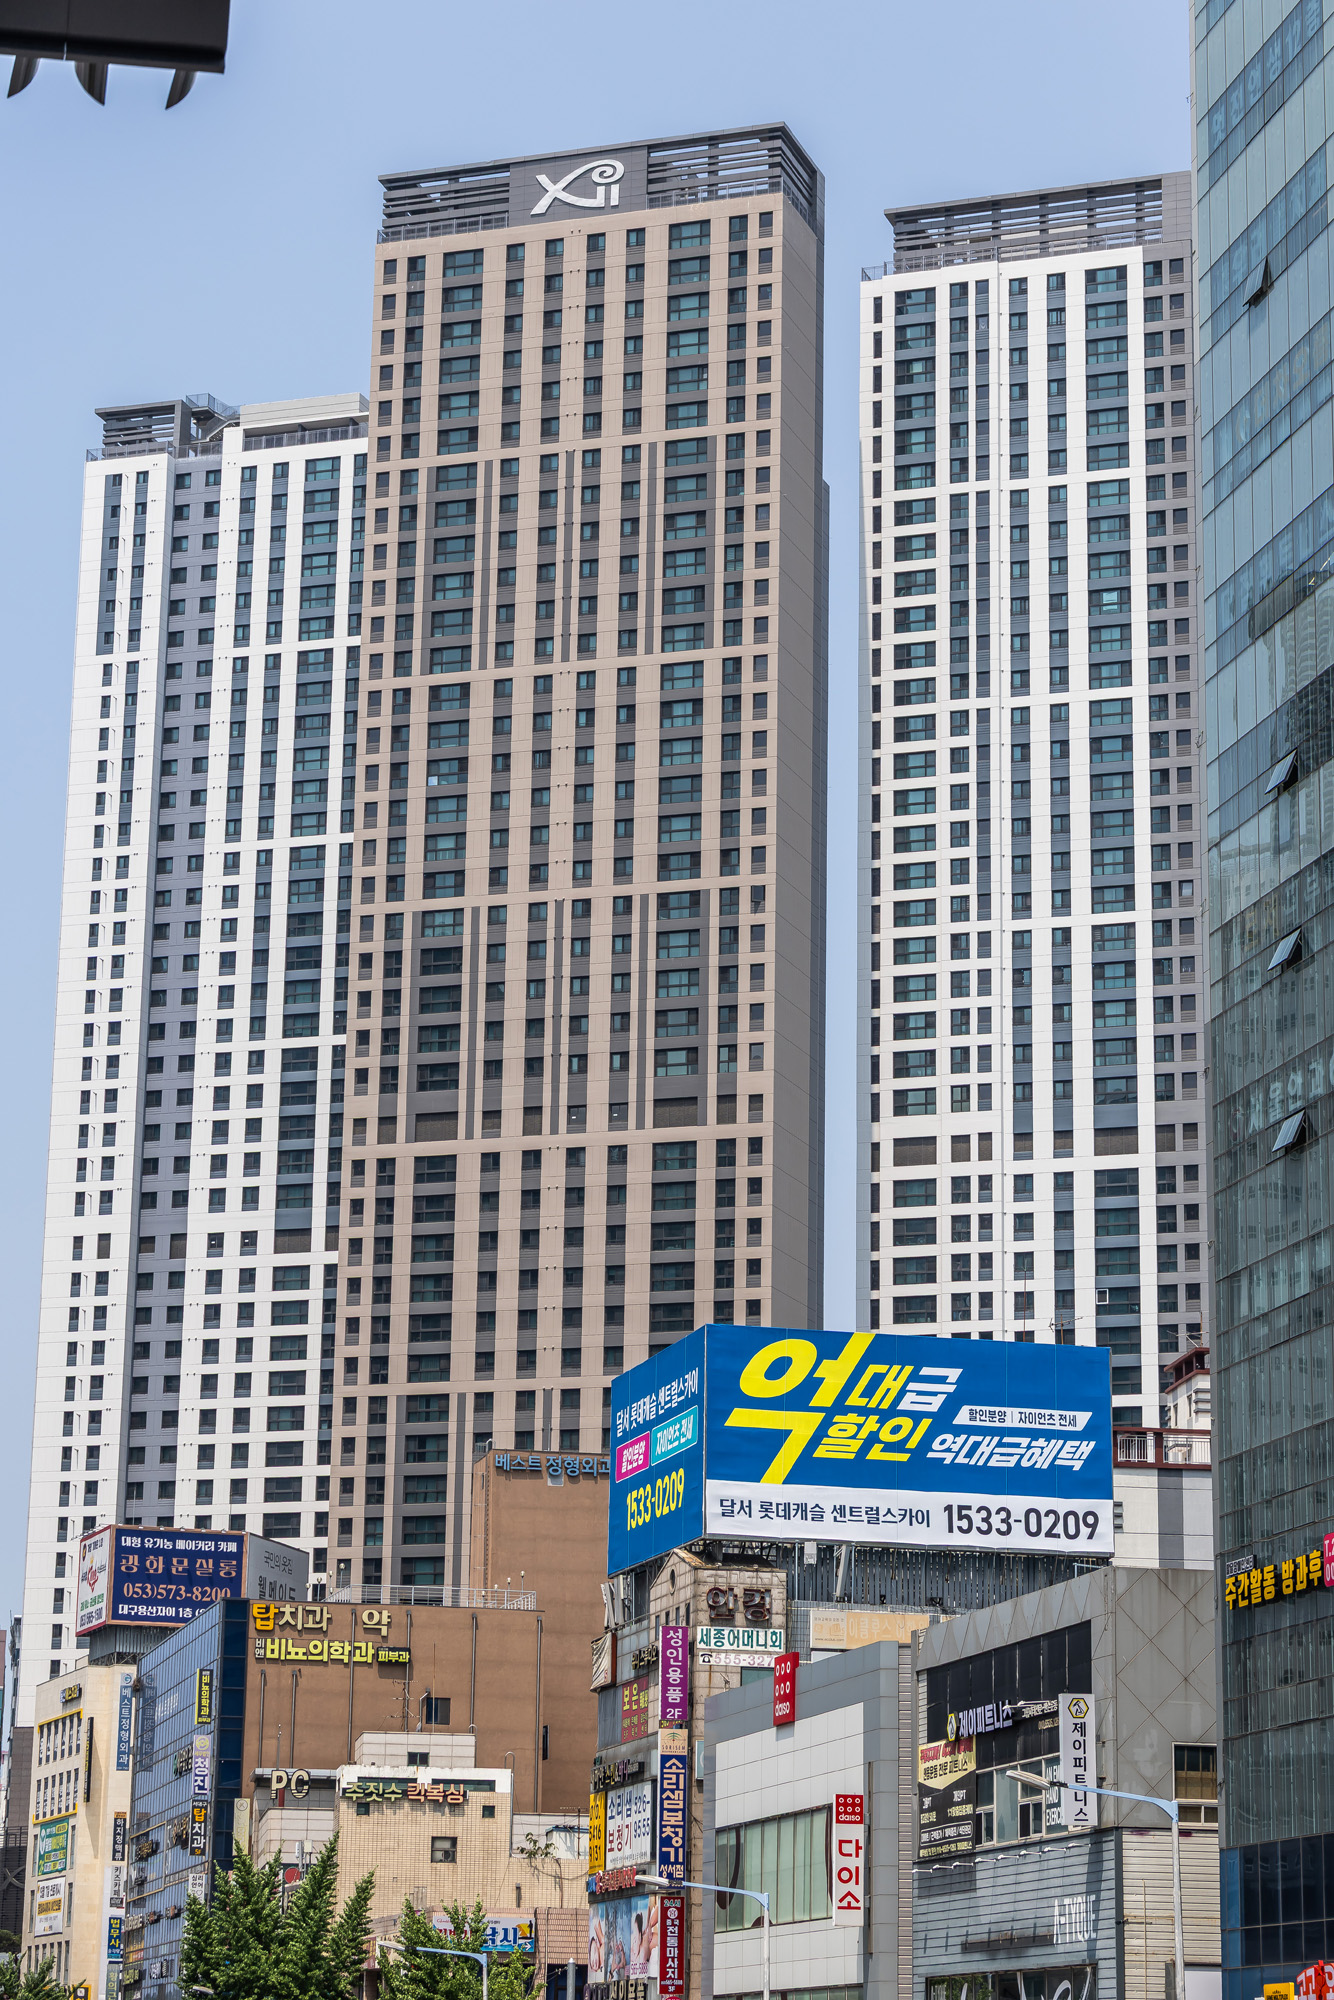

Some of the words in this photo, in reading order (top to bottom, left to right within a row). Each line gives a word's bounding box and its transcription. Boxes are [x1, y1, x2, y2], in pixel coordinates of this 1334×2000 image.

[616, 1406, 629, 1438] 달서
[631, 1392, 657, 1430] 롯데캐슬
[658, 1367, 699, 1415] 센트럴스카이
[968, 1408, 1007, 1424] 할인분양
[1018, 1411, 1056, 1426] 자이언츠
[1058, 1413, 1078, 1428] 전세
[681, 1414, 694, 1442] 전세
[495, 1453, 542, 1471] 베스트
[621, 1440, 646, 1474] 할인분양
[926, 1433, 1096, 1471] 역대급혜택
[627, 1467, 685, 1532] 1533-0209
[719, 1499, 753, 1519] 달서
[758, 1501, 826, 1522] 롯데캐슬
[831, 1504, 931, 1529] 센트럴스카이
[943, 1503, 1100, 1540] 1533-0209
[121, 1536, 141, 1548] 대형
[144, 1537, 173, 1550] 유기농
[176, 1539, 215, 1552] 베이커리
[218, 1541, 237, 1553] 카페
[264, 1550, 281, 1568] 국민의
[123, 1582, 231, 1601] 053)573-8200
[1225, 1565, 1276, 1610] 주간활동
[1282, 1549, 1322, 1595] 방과후
[118, 1604, 176, 1618] 대구용산자이
[178, 1608, 193, 1619] 1층
[252, 1603, 331, 1632] 탑치과
[361, 1609, 391, 1637] 약
[707, 1587, 771, 1621] 안경
[266, 1638, 374, 1664] 비뇨의학과
[378, 1651, 410, 1663] 피부과
[698, 1628, 783, 1650] 세종어머니회
[666, 1628, 684, 1703] 성인용품
[118, 1687, 131, 1764] 베스트정형외과
[666, 1708, 683, 1719] 2F
[775, 1701, 791, 1717] daiso
[958, 1700, 1013, 1738] 제이피트니스
[194, 1758, 209, 1794] 청진
[271, 1769, 311, 1799] PC
[1072, 1721, 1089, 1822] 제이피트니스
[345, 1782, 402, 1802] 주짓수
[407, 1783, 464, 1804] 킥복싱
[608, 1790, 632, 1820] 소리샘
[661, 1758, 685, 1862] 소리샘보청기
[191, 1808, 206, 1849] 탑치과
[839, 1813, 860, 1821] daiso
[114, 1819, 124, 1861] 하지정맥류
[607, 1822, 632, 1853] 보청기
[660, 1864, 684, 1878] 성서점
[837, 1839, 862, 1910] 다이소
[110, 1918, 120, 1948] 법무사
[1053, 1894, 1097, 1947] A-TYQUE
[666, 1926, 679, 1979] 전통마사지
